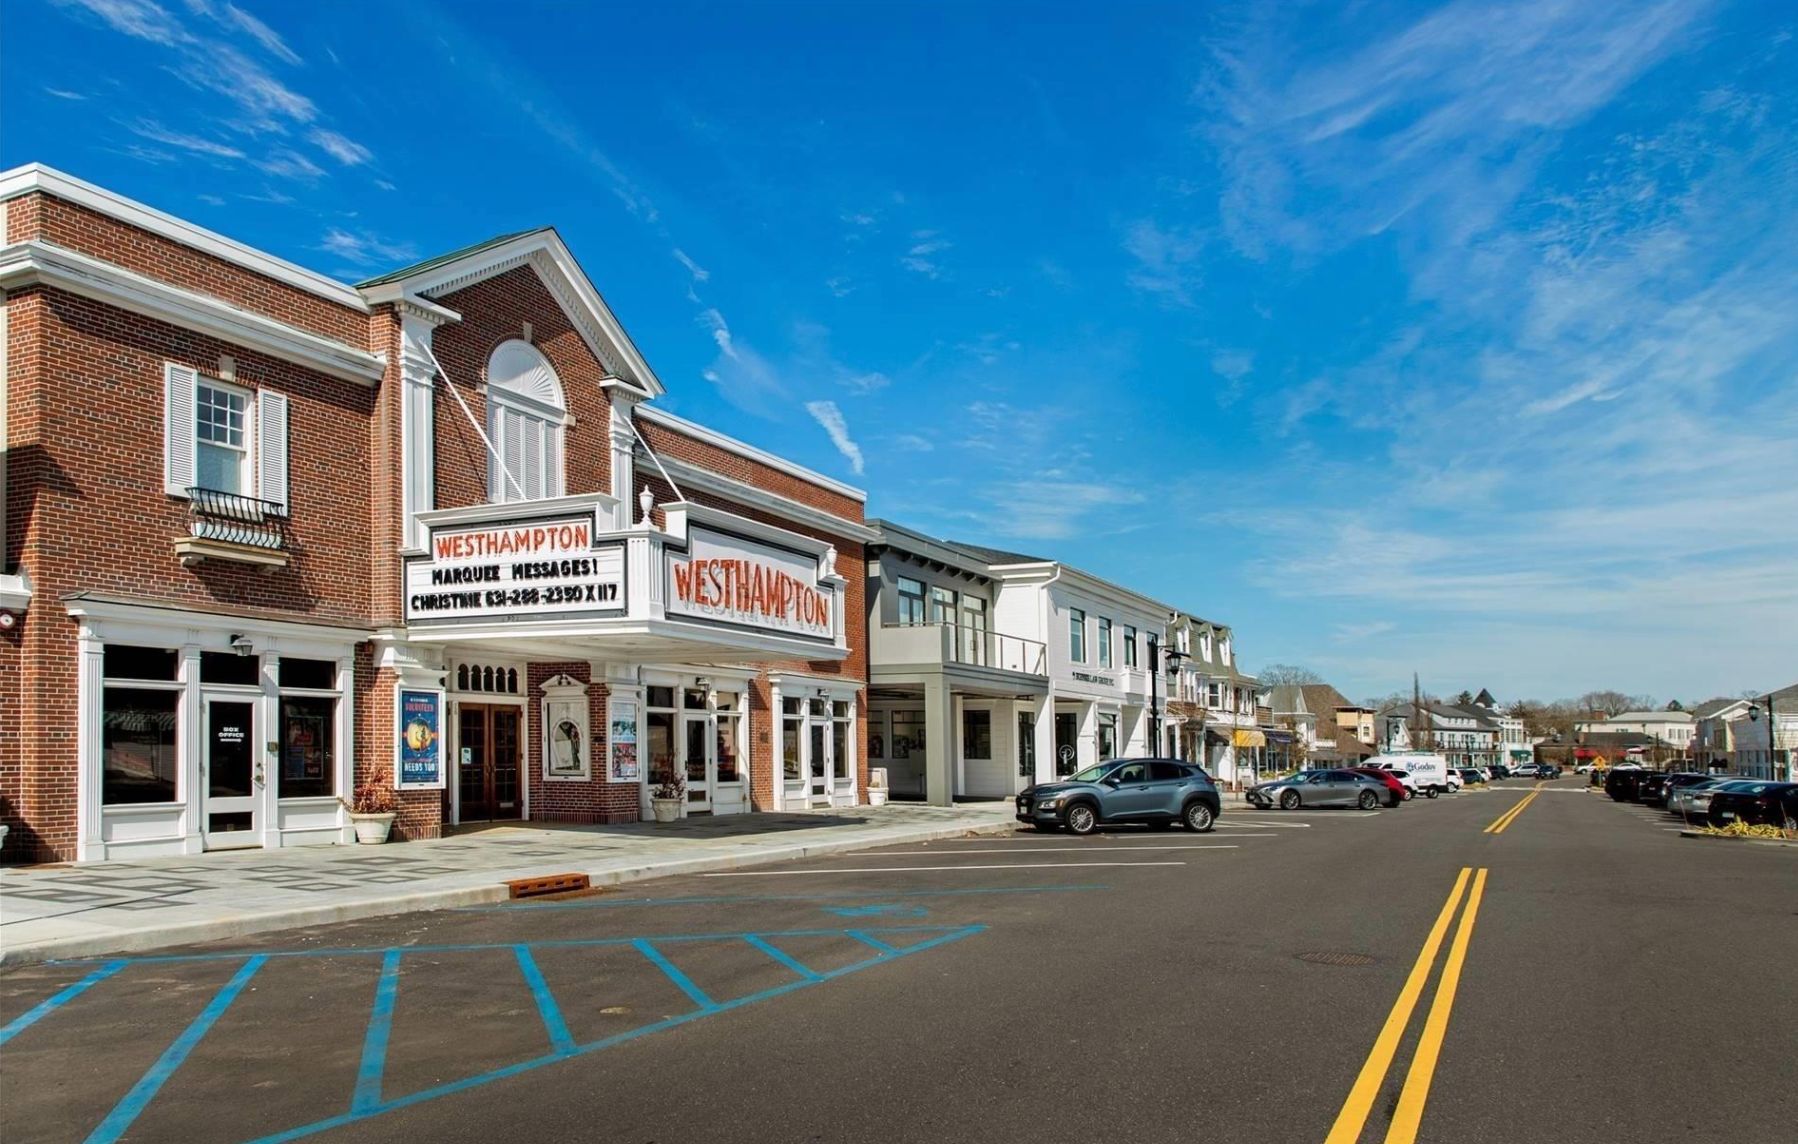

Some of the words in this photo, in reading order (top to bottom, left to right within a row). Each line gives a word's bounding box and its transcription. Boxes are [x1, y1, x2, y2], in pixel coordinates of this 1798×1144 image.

[436, 525, 588, 558] WESTHAMPTON
[432, 564, 501, 586] MARQUEE
[512, 558, 598, 580] MESSAGES!
[411, 591, 482, 611] CHRISTINE
[673, 558, 828, 627] WESTHAMPTON
